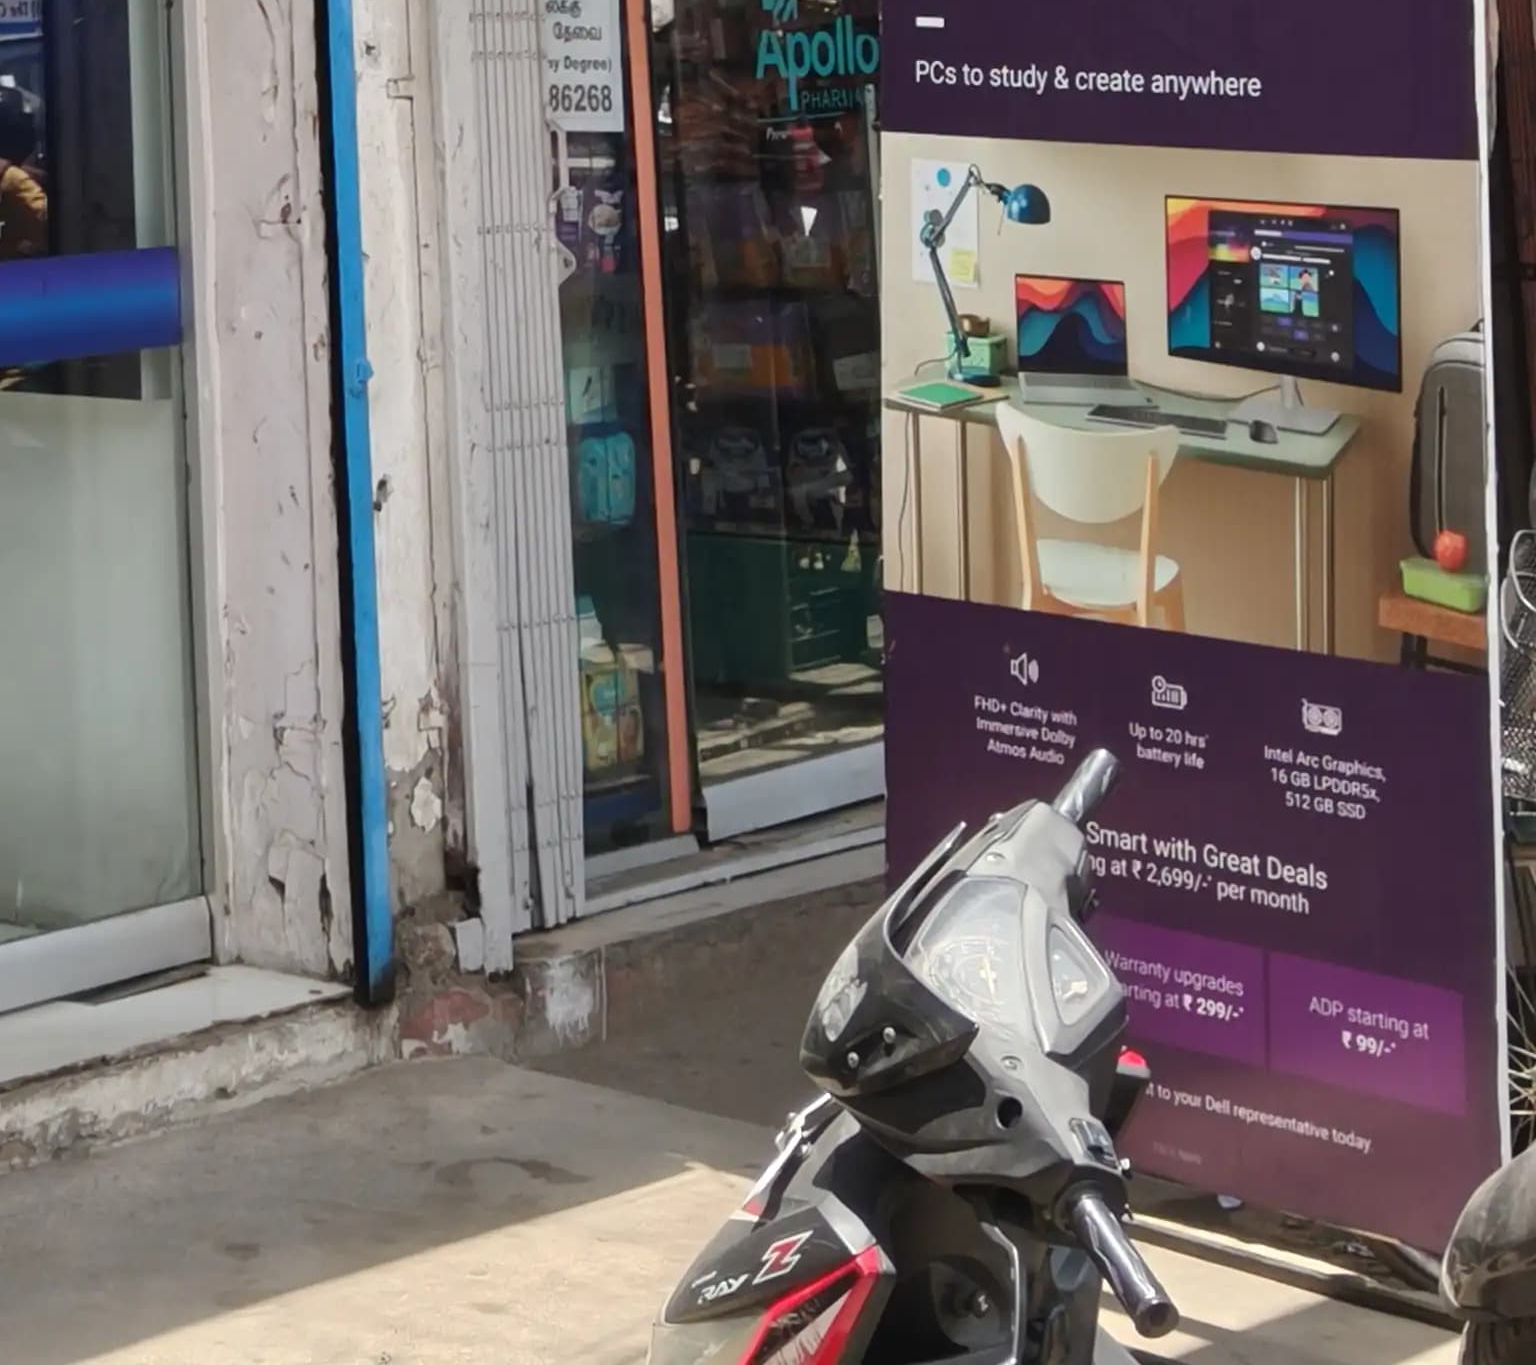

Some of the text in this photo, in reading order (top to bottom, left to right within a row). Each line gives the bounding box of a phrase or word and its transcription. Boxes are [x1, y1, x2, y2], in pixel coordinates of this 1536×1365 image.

[756, 14, 880, 111] Apollo
[915, 60, 1262, 101] PCs to study & create anywhere
[974, 695, 1077, 725] FHD+ Clarity with
[976, 717, 1076, 748] Immersive Dolby
[1129, 722, 1182, 744] Up to 20
[987, 738, 1065, 765] Atmos Audio
[1137, 743, 1205, 769] battery life
[1264, 745, 1293, 764] Intel
[1296, 751, 1320, 768] Arc
[1271, 767, 1310, 788] 16 GB
[1285, 792, 1366, 821] 512 GB SSD
[1086, 821, 1328, 890] Smart with Great Deals
[1110, 859, 1128, 876] at
[1217, 880, 1245, 902] per
[1251, 887, 1310, 914] month
[1104, 949, 1244, 997] Warranty upgrades
[1165, 991, 1180, 1009] at
[1309, 996, 1429, 1041] ADP starting at
[1158, 1084, 1171, 1101] to
[1173, 1088, 1202, 1114] your
[1205, 1095, 1230, 1116] Dell
[1233, 1103, 1329, 1141] representative
[1332, 1128, 1372, 1154] today
[697, 1273, 750, 1305] RAY
